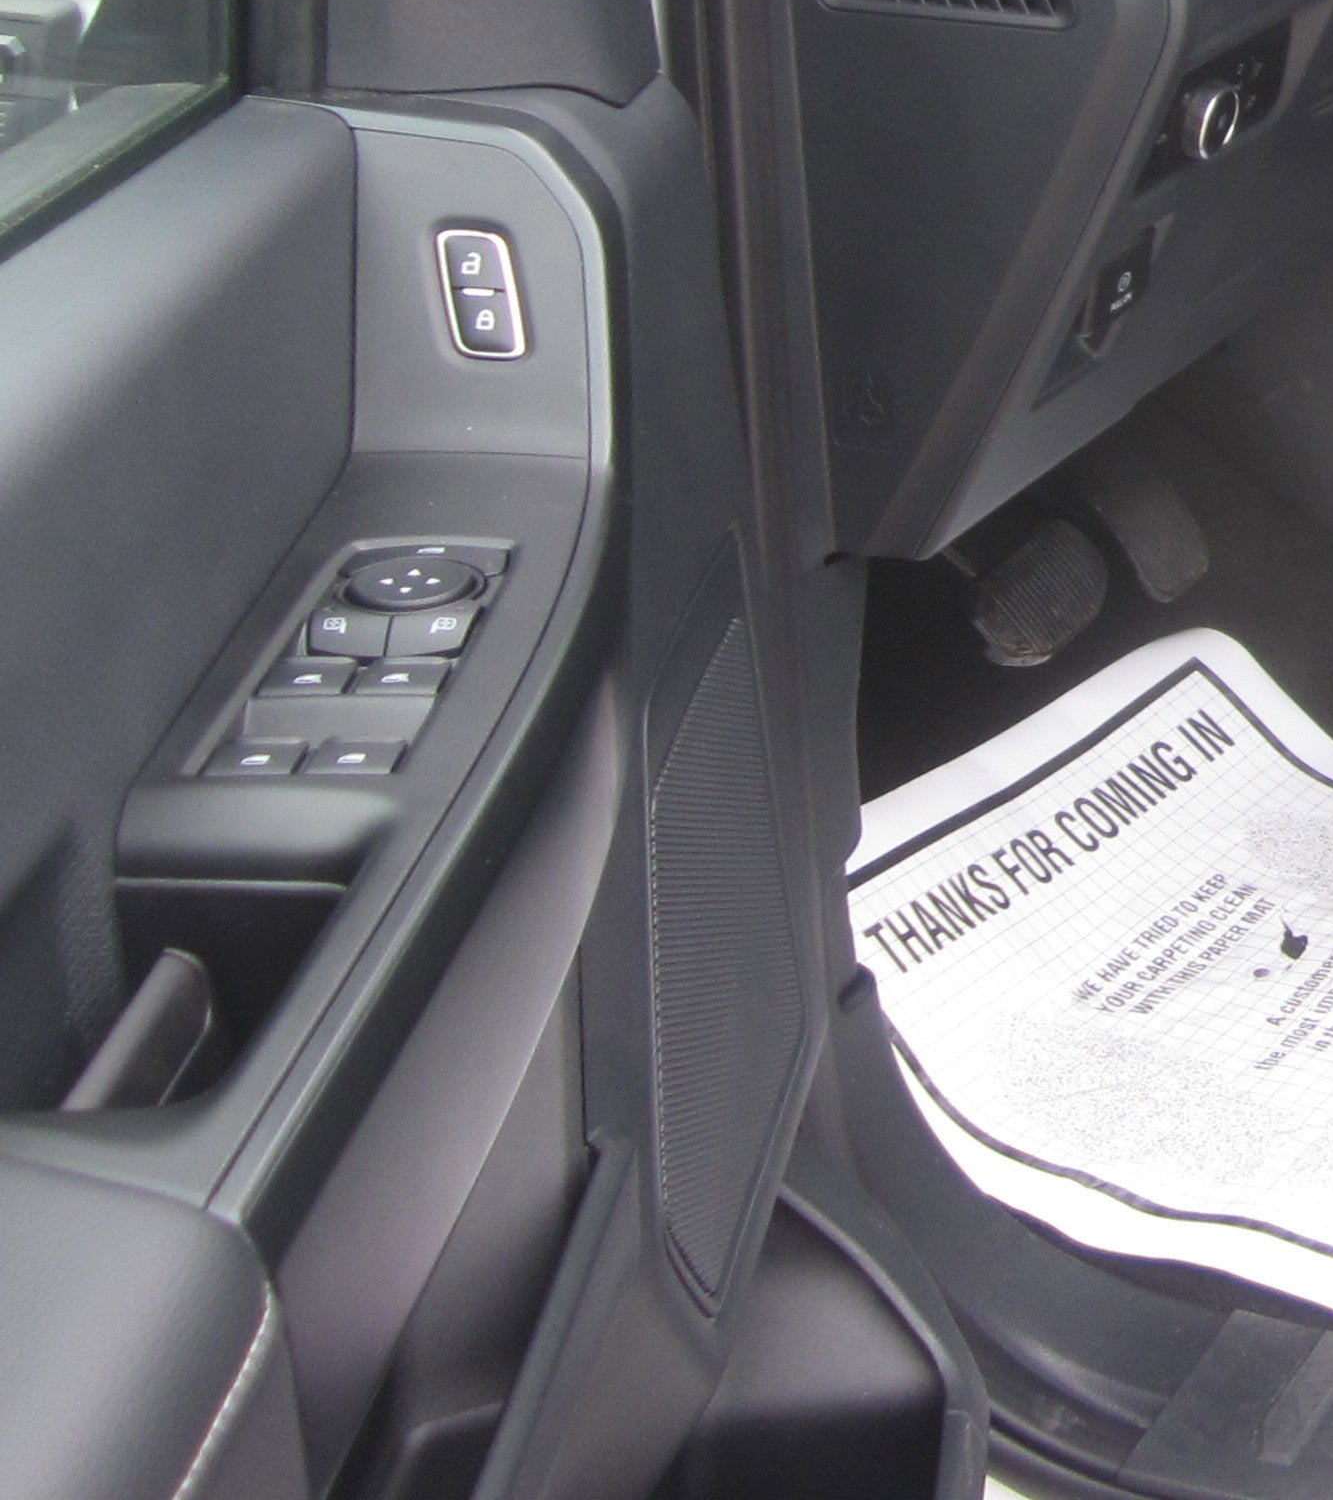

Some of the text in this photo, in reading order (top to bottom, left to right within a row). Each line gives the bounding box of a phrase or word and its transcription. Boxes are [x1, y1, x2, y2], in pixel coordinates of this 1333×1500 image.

[863, 709, 1235, 973] THANKS FOR COMING IN
[1071, 873, 1229, 1002] WE HAVE TRIED TO KEEP
[1097, 883, 1258, 1014] YOUR CARPETING CLEAN
[1130, 897, 1276, 1015] WITH THIS PAPER MAT
[1254, 1051, 1286, 1070] the
[1281, 1017, 1321, 1049] most
[1266, 1015, 1287, 1026] A
[1306, 1040, 1331, 1052] in
